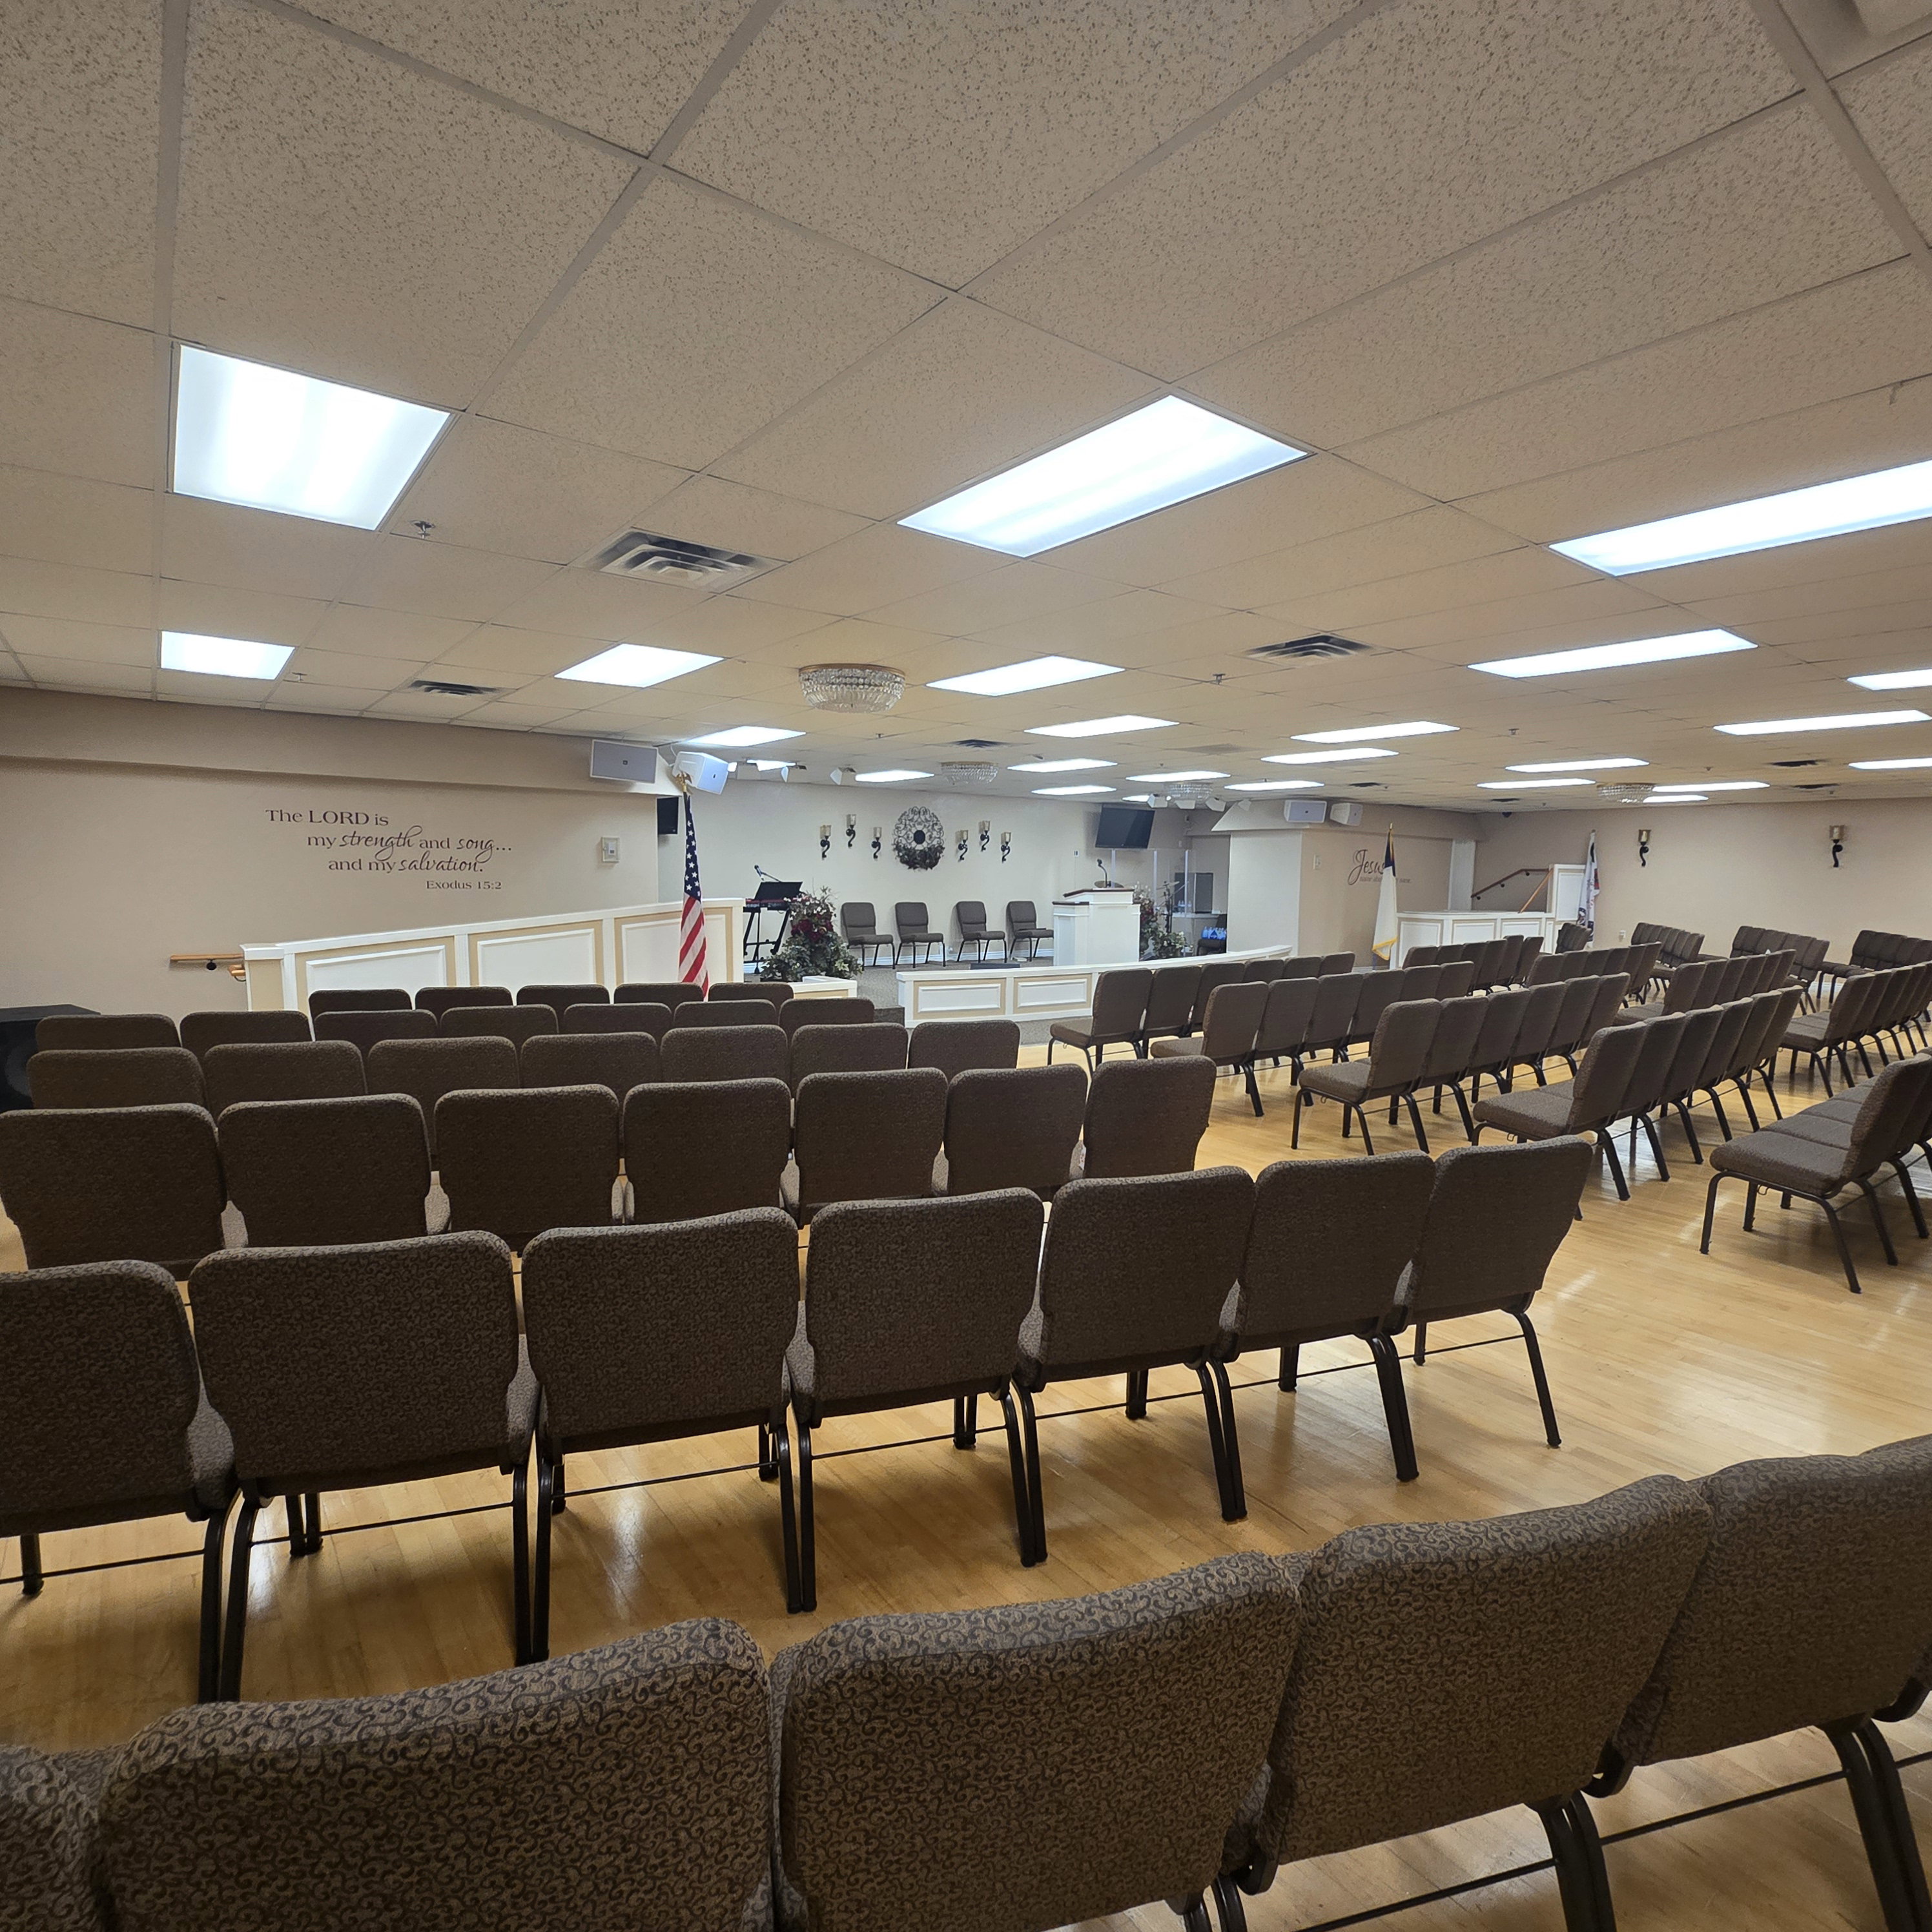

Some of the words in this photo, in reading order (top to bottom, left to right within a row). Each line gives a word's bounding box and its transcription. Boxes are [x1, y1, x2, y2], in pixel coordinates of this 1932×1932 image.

[265, 810, 303, 823] The
[309, 810, 369, 824] LORD
[375, 814, 389, 825] is
[307, 836, 336, 849] my
[339, 825, 423, 861] strength
[419, 838, 451, 849] and
[456, 838, 512, 863] song...
[328, 859, 362, 871] and
[369, 860, 396, 874] my
[398, 850, 484, 872] salvation.
[426, 880, 472, 890] Exodus
[477, 881, 502, 890] 15:2
